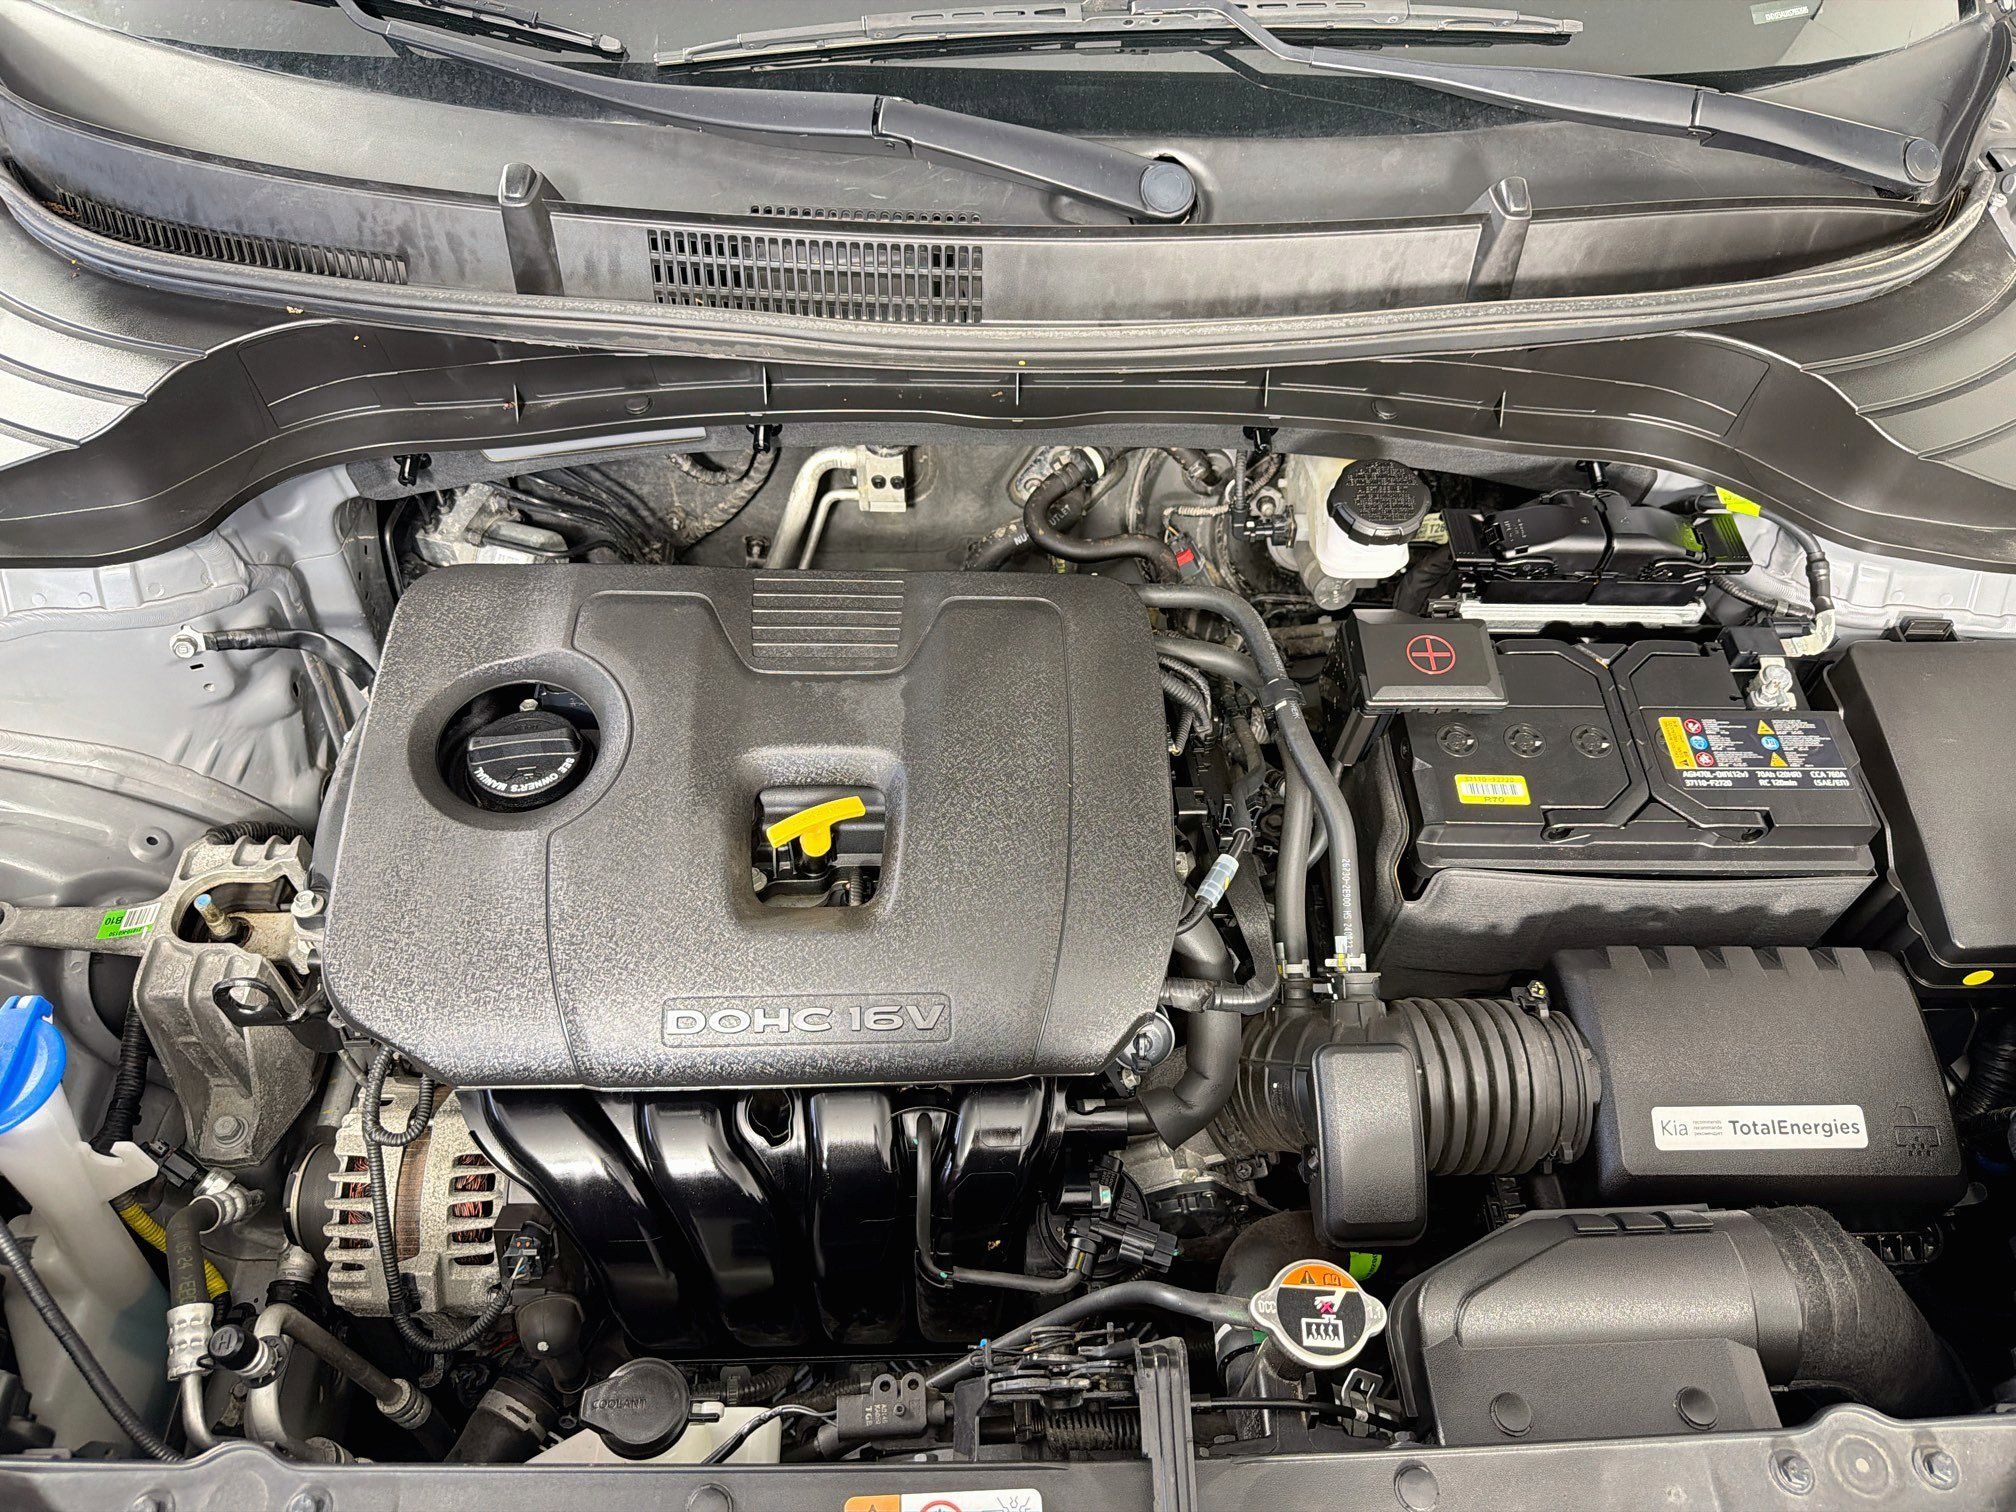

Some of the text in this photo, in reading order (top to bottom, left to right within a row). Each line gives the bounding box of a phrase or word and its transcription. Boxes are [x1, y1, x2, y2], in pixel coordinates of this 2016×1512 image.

[473, 757, 576, 793] SEE OWNER'S MANUAL
[1759, 779, 1771, 787] RC
[104, 915, 125, 926] B10
[665, 1004, 946, 1035] DOHC 16V
[1660, 1120, 1688, 1136] Kia
[1727, 1118, 1860, 1138] TotalEnergies
[591, 1398, 647, 1411] COOLANT
